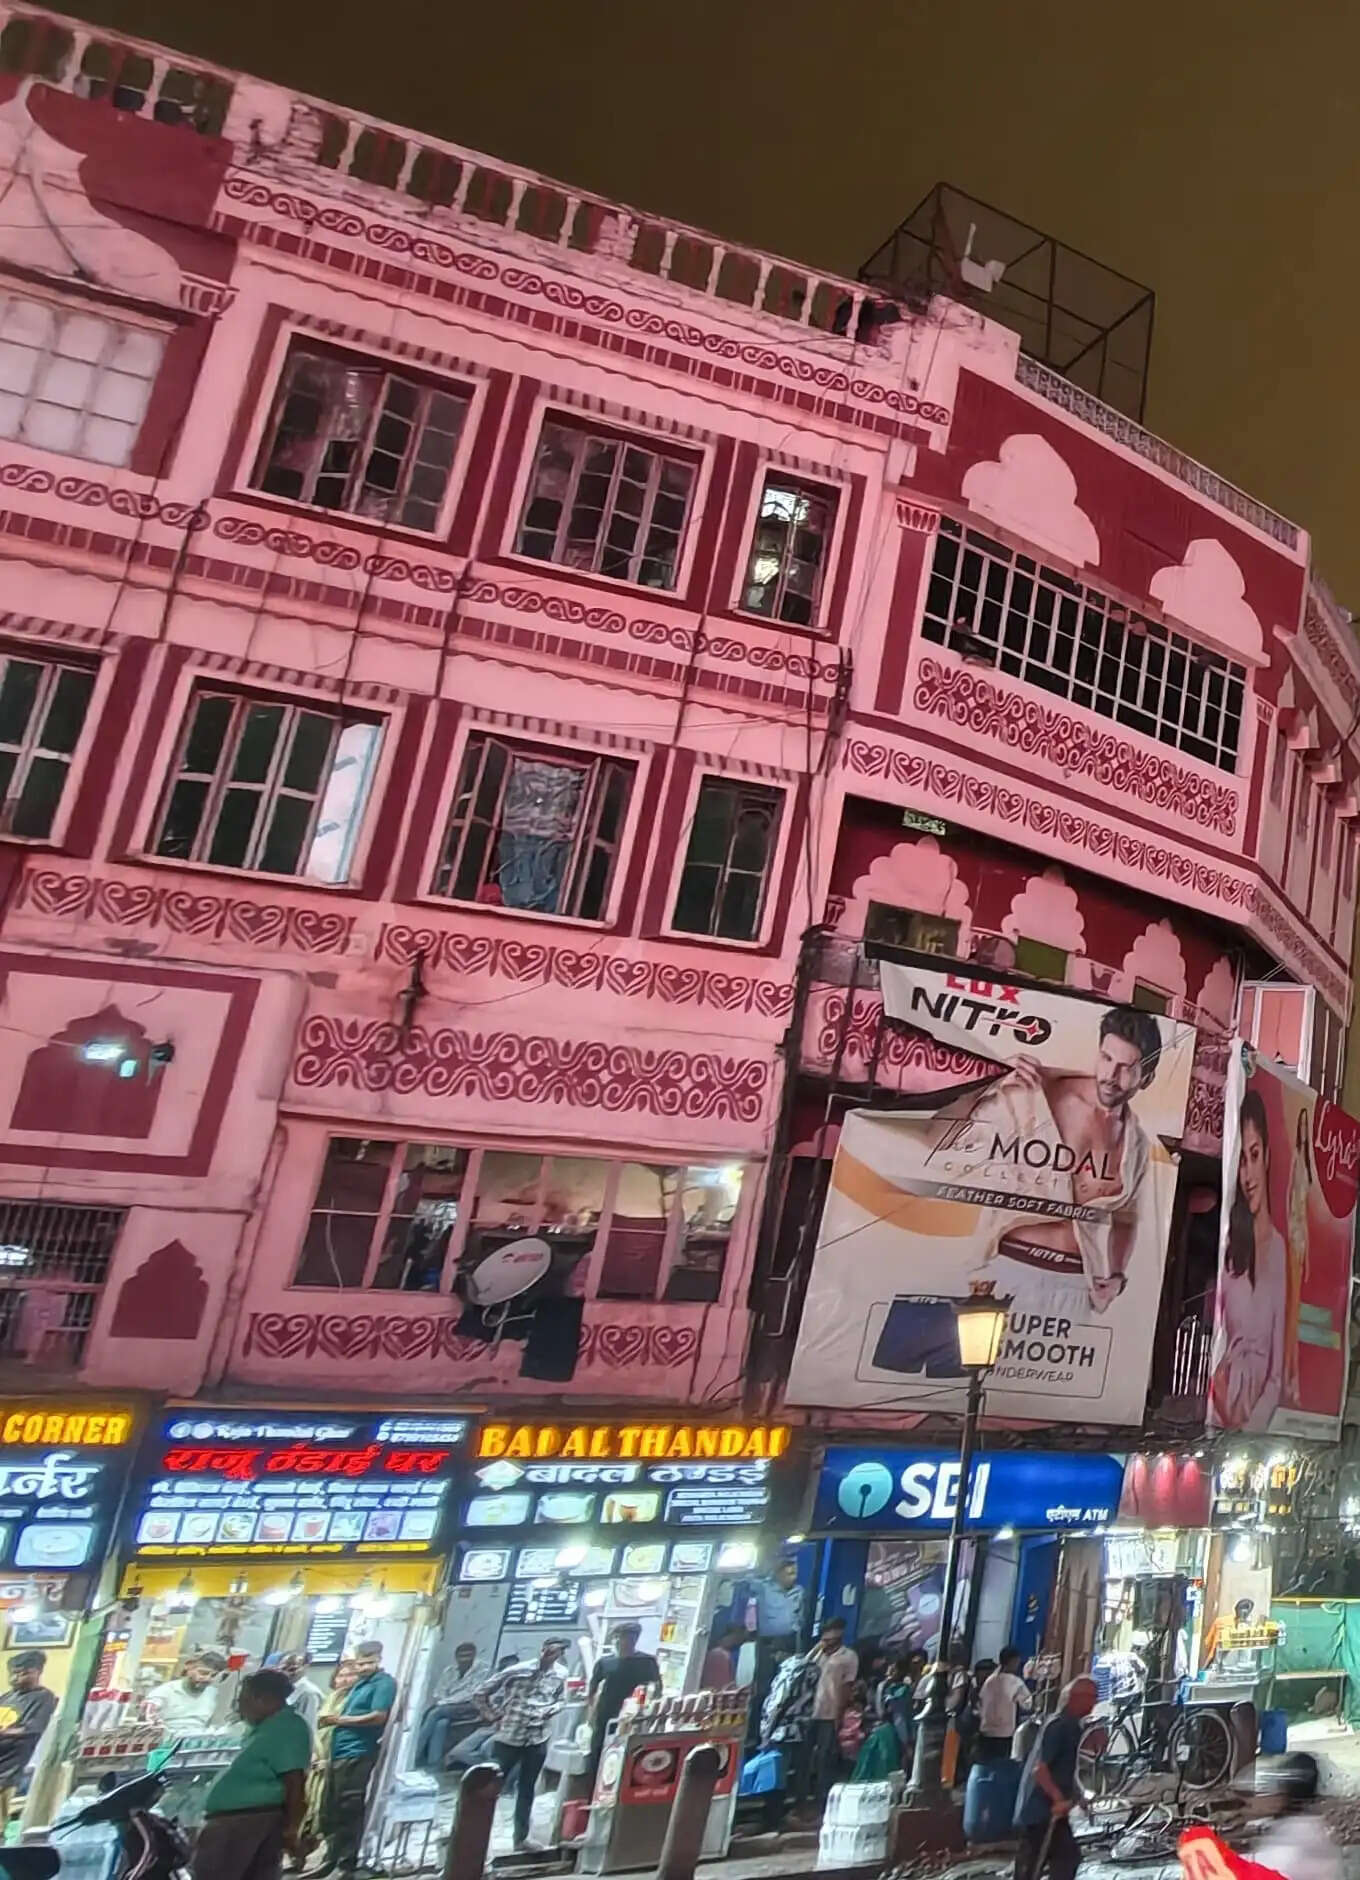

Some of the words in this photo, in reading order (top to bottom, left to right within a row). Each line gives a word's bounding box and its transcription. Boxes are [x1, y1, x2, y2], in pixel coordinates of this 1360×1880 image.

[945, 973, 1023, 1005] LUX
[989, 1132, 1116, 1181] MODAL
[944, 1160, 1104, 1198] COLLECTIO
[936, 1185, 1004, 1204] FEATHER
[1007, 1196, 1044, 1212] SOFT
[1046, 1203, 1097, 1221] FABRIC
[988, 1365, 1074, 1382] NDERWEAR
[2, 1413, 130, 1445] CORNER
[616, 1426, 788, 1458] THANDAI
[0, 1453, 101, 1499] र्नर
[163, 1447, 262, 1481] राजू
[525, 1463, 641, 1483] बादल
[896, 1462, 990, 1518] SBI
[1083, 1508, 1109, 1521] ATM
